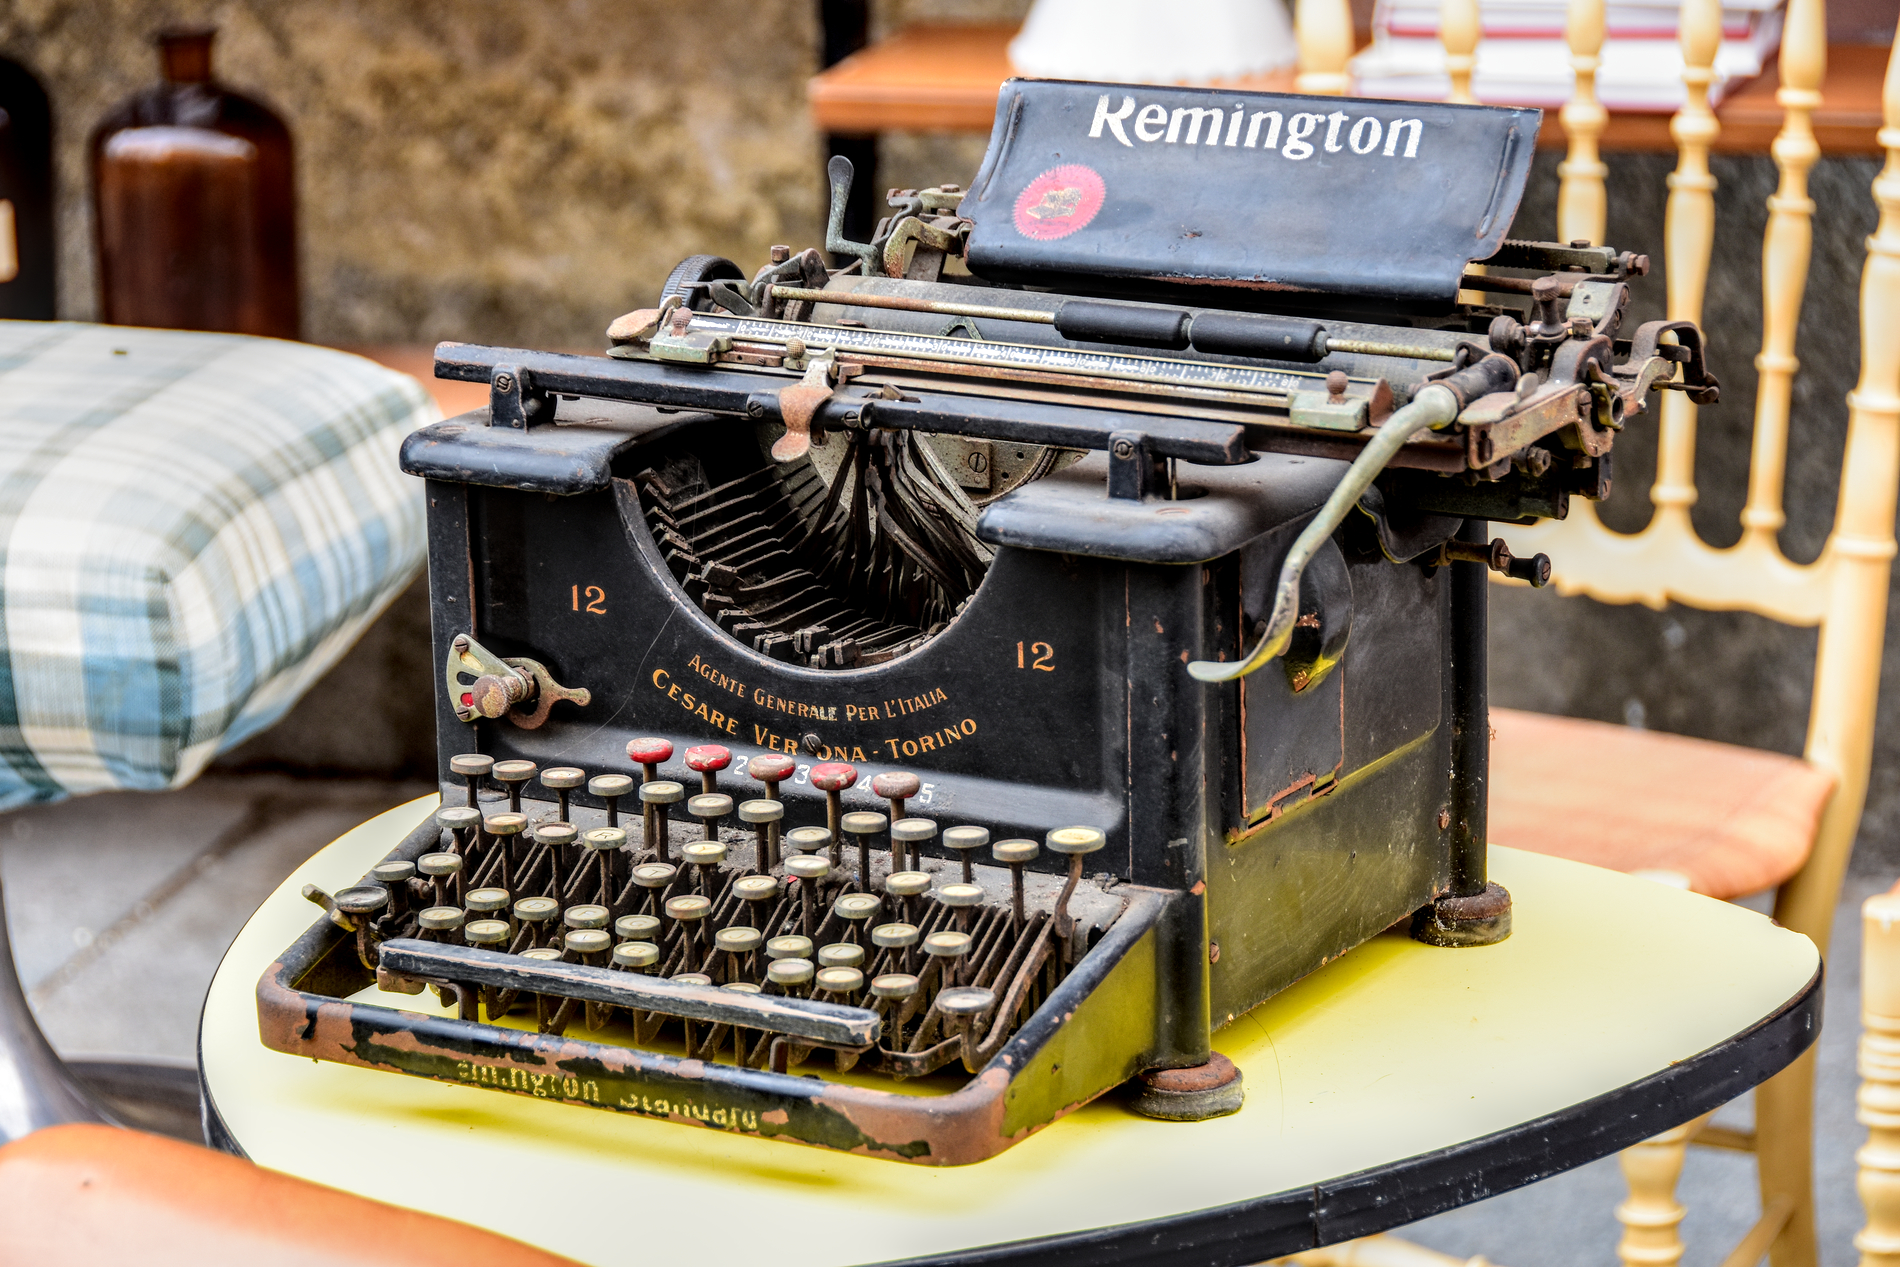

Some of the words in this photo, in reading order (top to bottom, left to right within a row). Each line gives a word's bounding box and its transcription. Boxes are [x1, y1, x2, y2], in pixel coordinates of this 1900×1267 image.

[1088, 94, 1423, 160] Remington
[571, 584, 608, 615] 12
[1016, 641, 1056, 672] 12
[652, 668, 739, 735] CESARE
[885, 718, 977, 759] TORINO
[687, 654, 747, 698] AGENTE
[754, 688, 838, 722] GENERALE
[846, 704, 881, 722] PER
[884, 687, 948, 719] L'ITALIA
[733, 755, 749, 776] 2
[795, 763, 811, 784] 3
[856, 775, 872, 792] 4
[919, 783, 935, 804] 5
